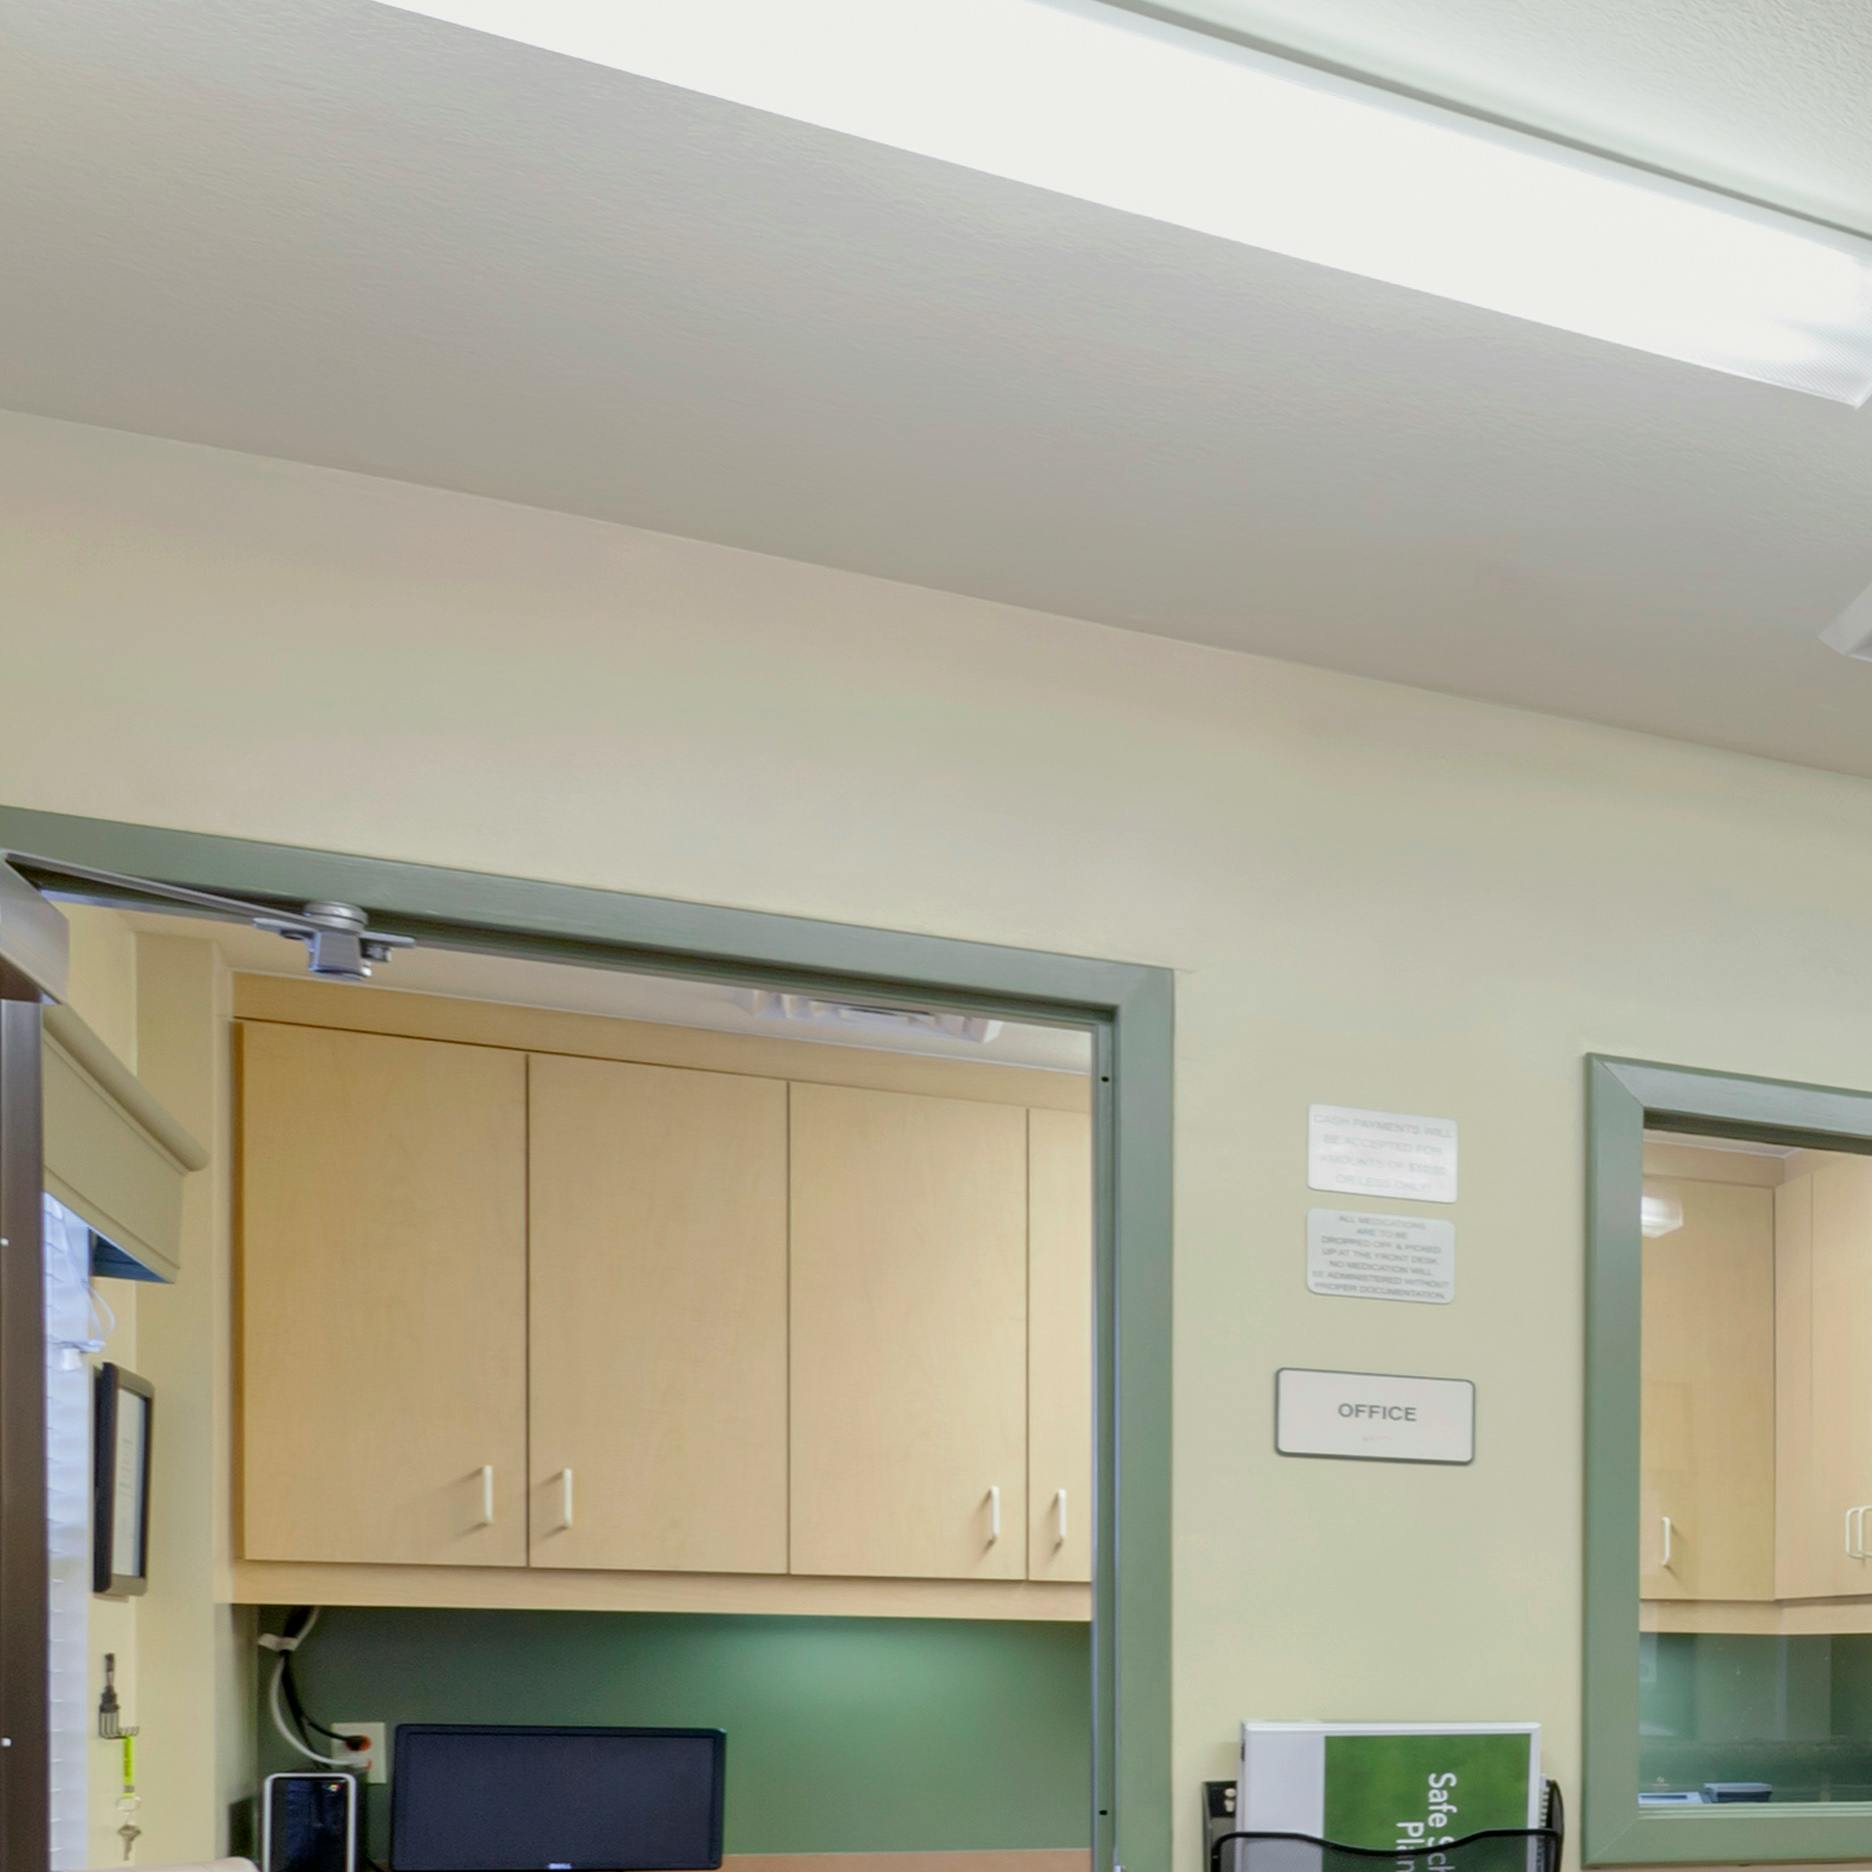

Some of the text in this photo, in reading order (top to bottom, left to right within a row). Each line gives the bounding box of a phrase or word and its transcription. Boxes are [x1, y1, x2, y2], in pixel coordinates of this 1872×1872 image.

[1313, 1113, 1453, 1139] CASH PAYMENTS WILL
[1322, 1133, 1443, 1156] BE ACCEPTED FOR
[1338, 1214, 1427, 1231] ALL MEDICATIONS
[1356, 1228, 1409, 1240] ARE TO BE
[1321, 1248, 1337, 1258] UP
[1337, 1248, 1351, 1258] AT
[1352, 1249, 1372, 1261] THE
[1374, 1252, 1409, 1264] FRONT
[1403, 1243, 1442, 1255] PICKED
[1328, 1259, 1433, 1277] NO MEDICATION WILL
[1312, 1281, 1357, 1292] PROPER
[1326, 1271, 1404, 1286] ADMINISTERED
[1404, 1278, 1450, 1289] WITHOUT
[1337, 1402, 1418, 1423] OFFICE
[1427, 1771, 1459, 1829] Safe
